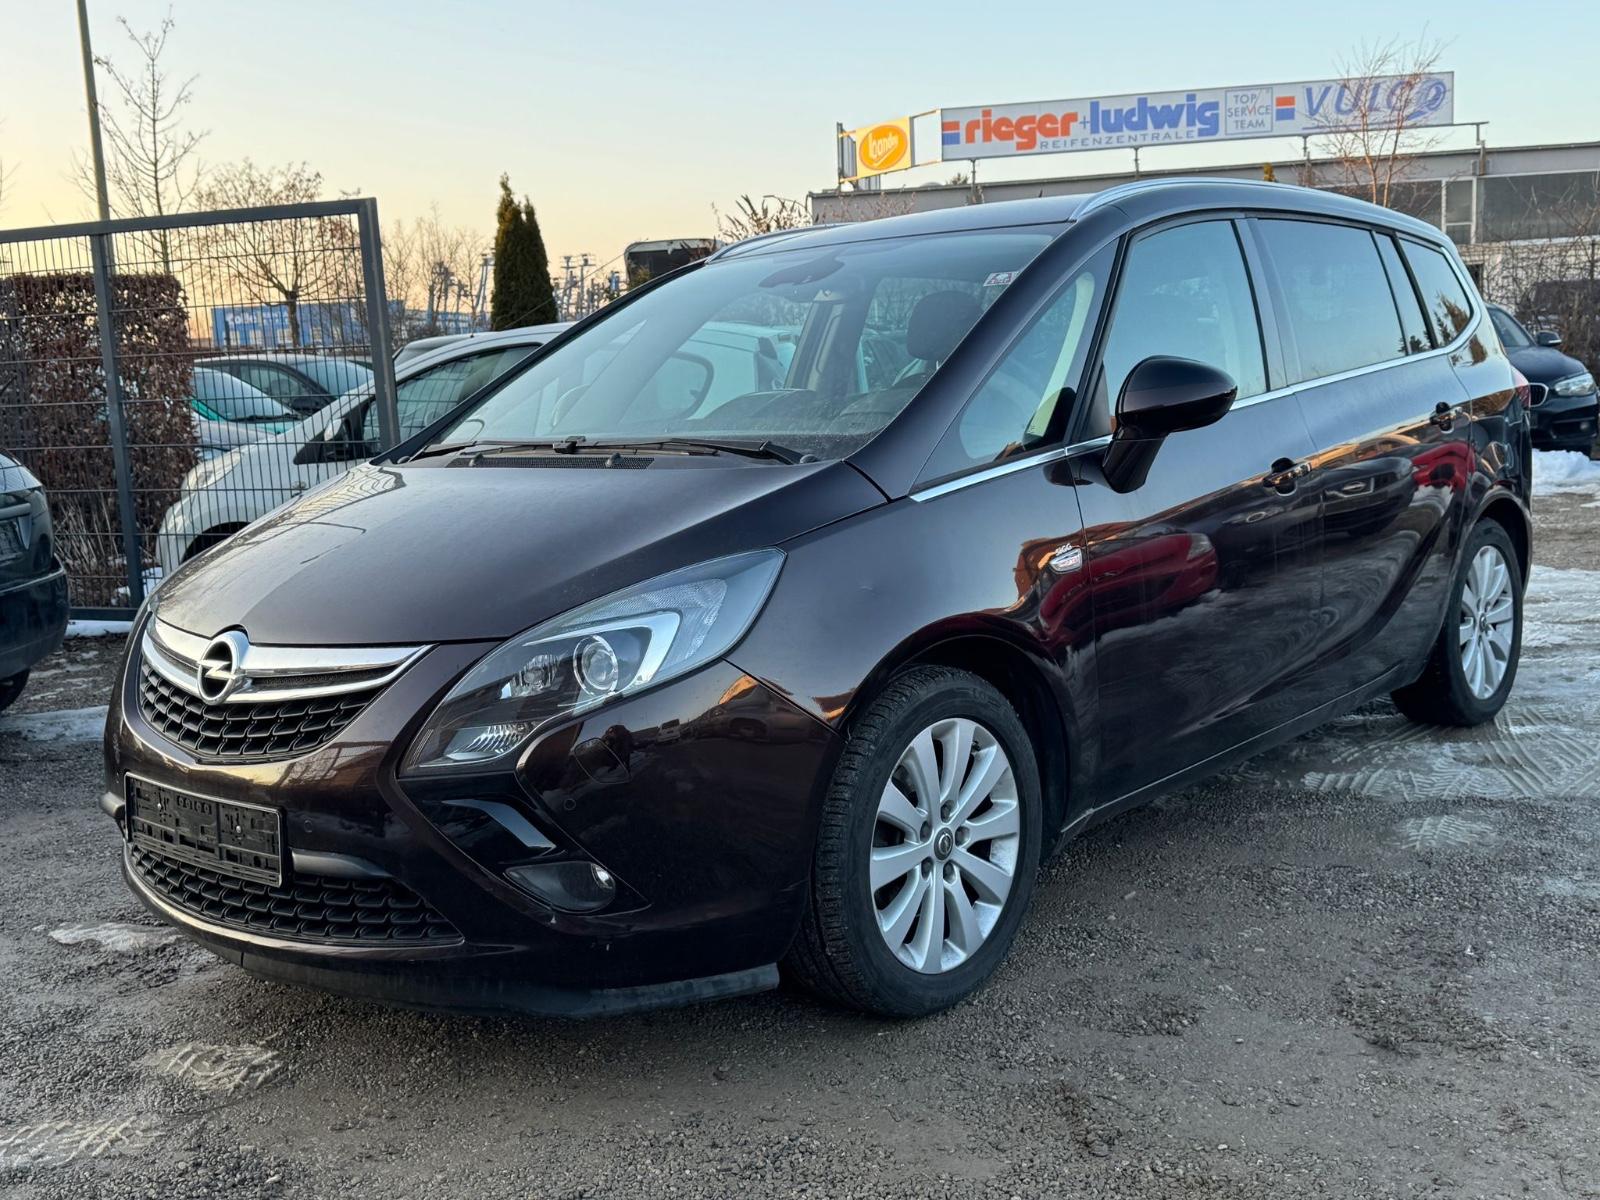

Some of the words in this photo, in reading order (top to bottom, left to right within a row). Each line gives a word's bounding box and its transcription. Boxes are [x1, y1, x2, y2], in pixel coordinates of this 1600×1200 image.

[1233, 94, 1257, 105] TOP
[1227, 104, 1271, 118] SERVICE
[1234, 119, 1266, 130] TEAM
[1040, 130, 1194, 150] REIFENZENTRALE
